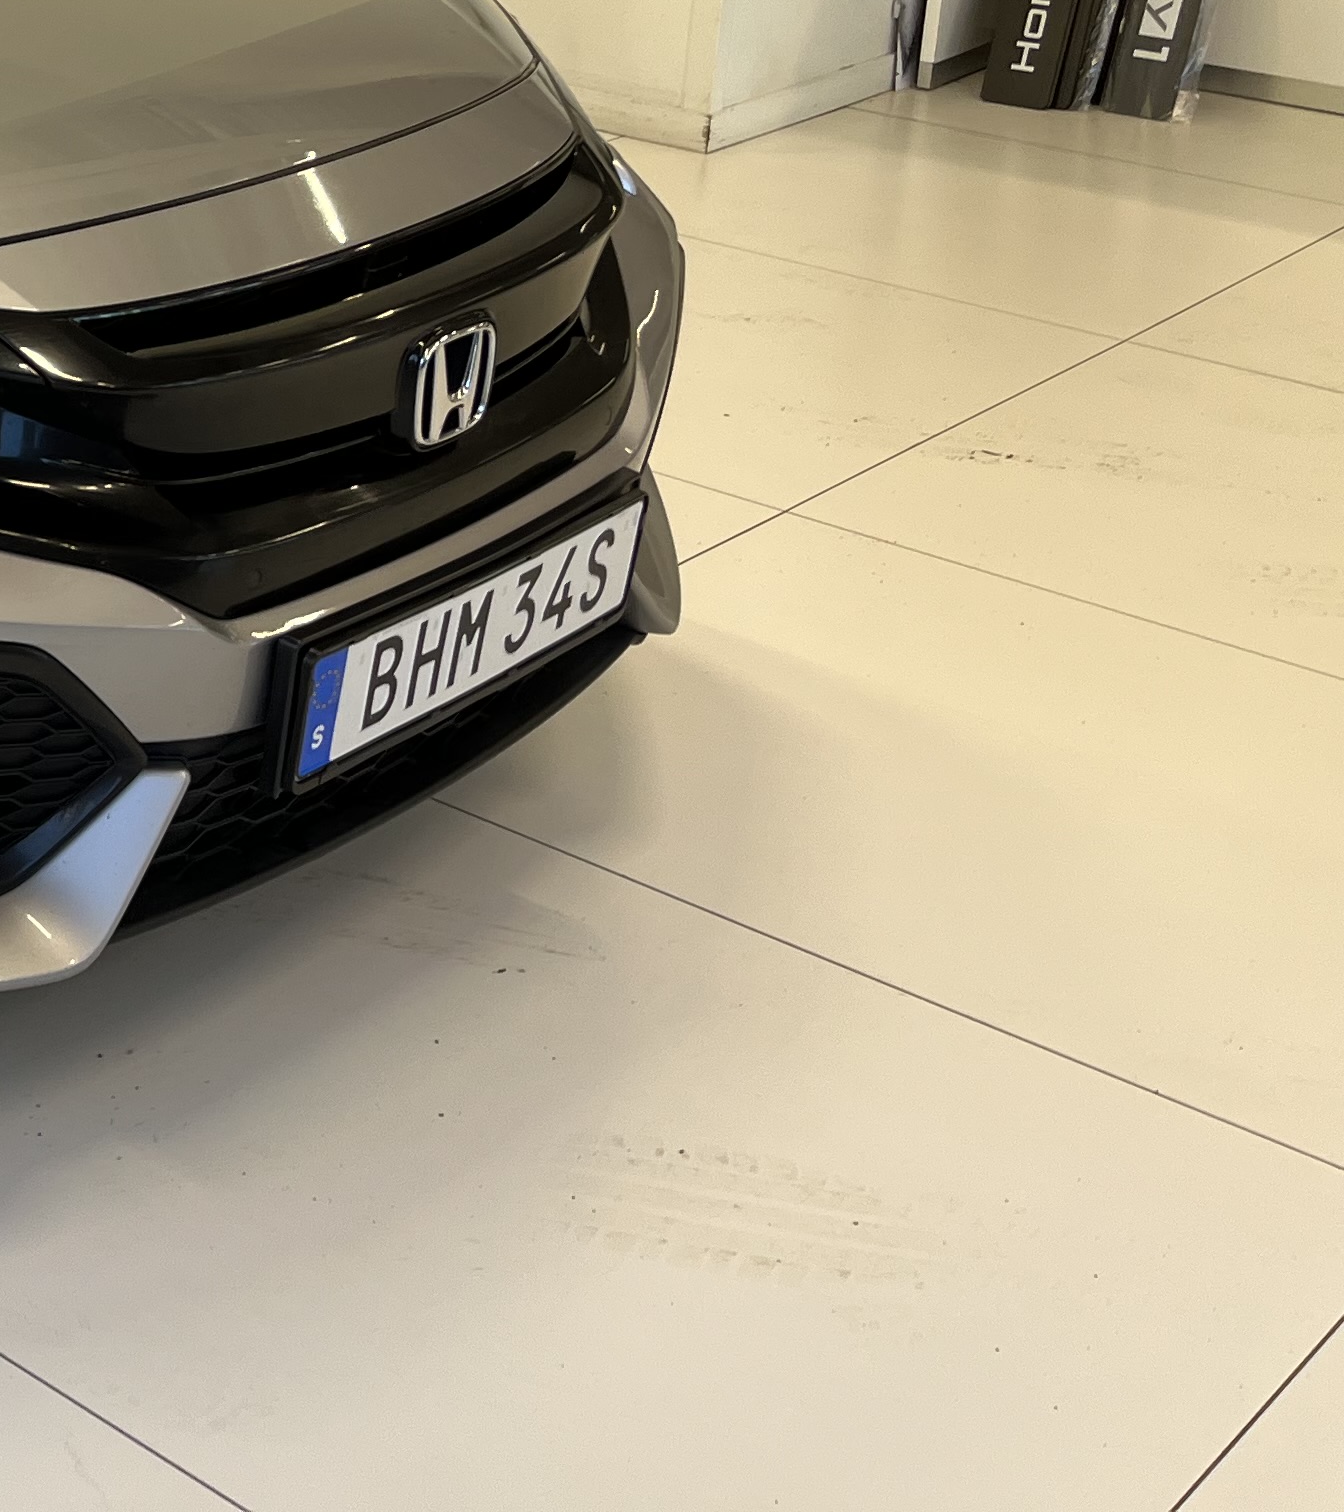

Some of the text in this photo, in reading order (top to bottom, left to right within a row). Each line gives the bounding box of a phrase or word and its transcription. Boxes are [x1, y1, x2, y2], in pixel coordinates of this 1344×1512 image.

[360, 527, 615, 731] BHM 34S
[311, 724, 325, 750] S
